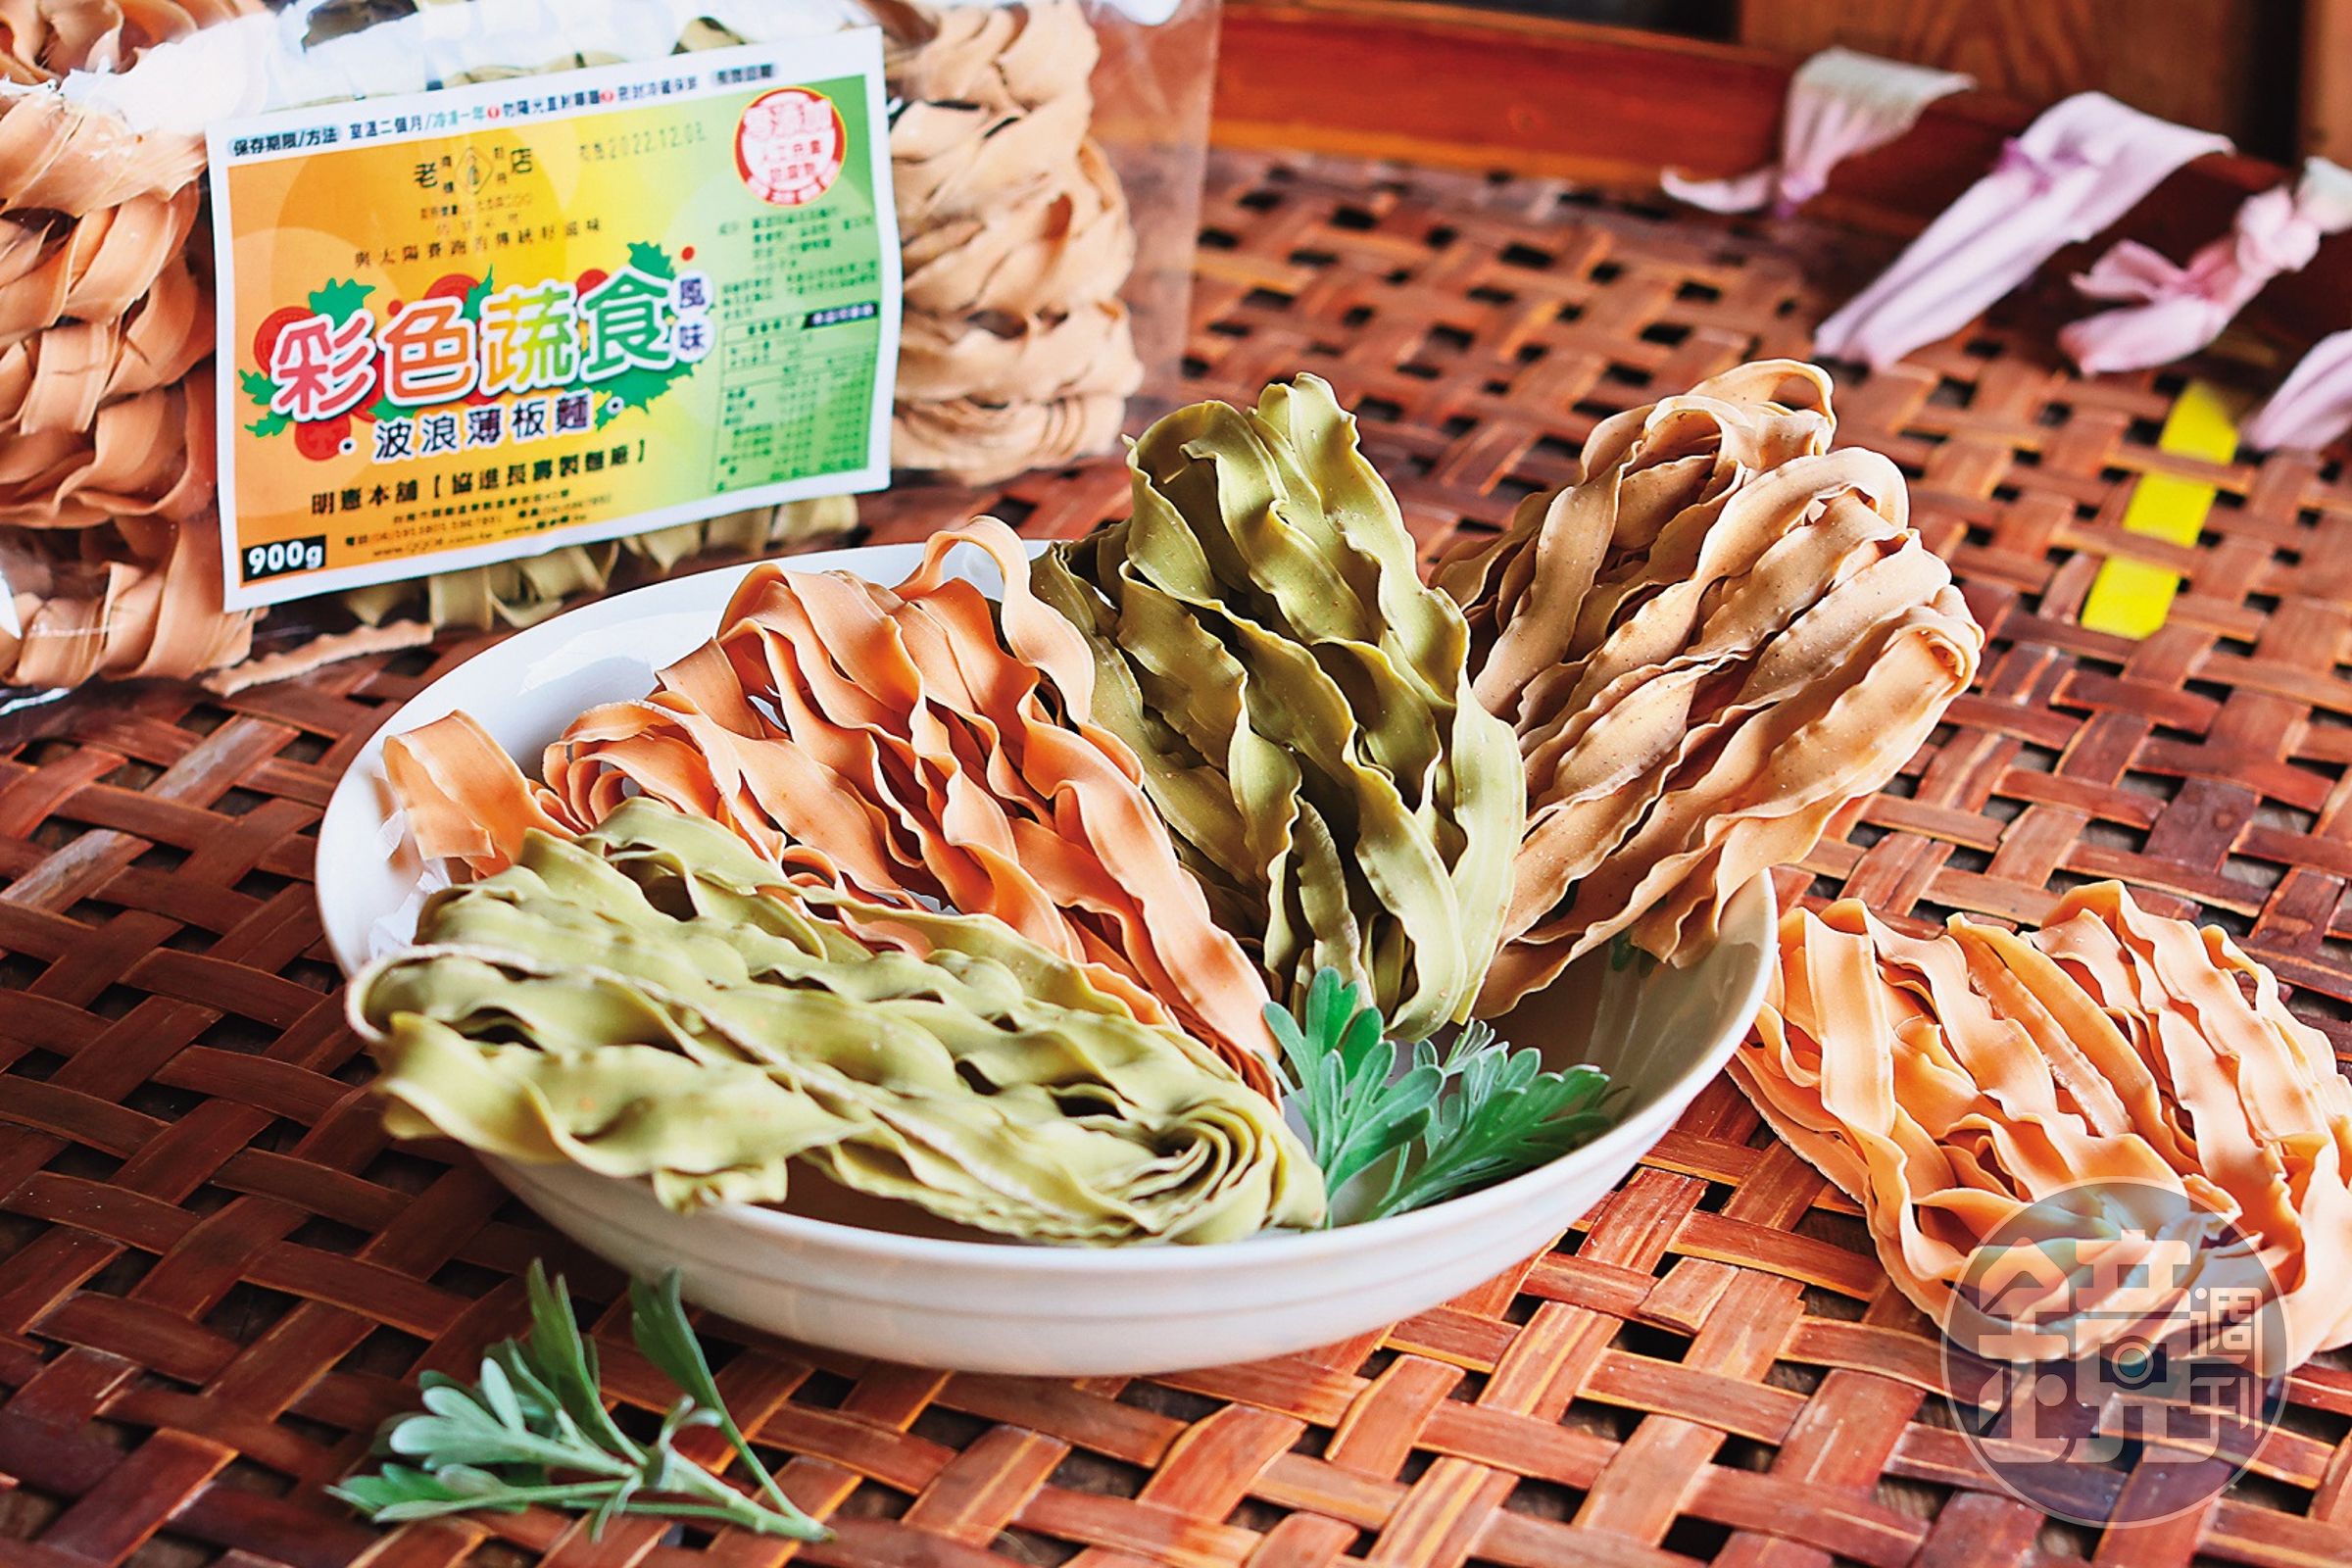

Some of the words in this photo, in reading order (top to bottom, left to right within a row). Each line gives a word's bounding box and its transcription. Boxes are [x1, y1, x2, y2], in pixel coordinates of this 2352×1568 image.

[270, 267, 674, 421] 彩色蔬食
[676, 276, 708, 353] 風味
[374, 396, 590, 461] 波浪薄板麵
[247, 539, 324, 574] 900g
